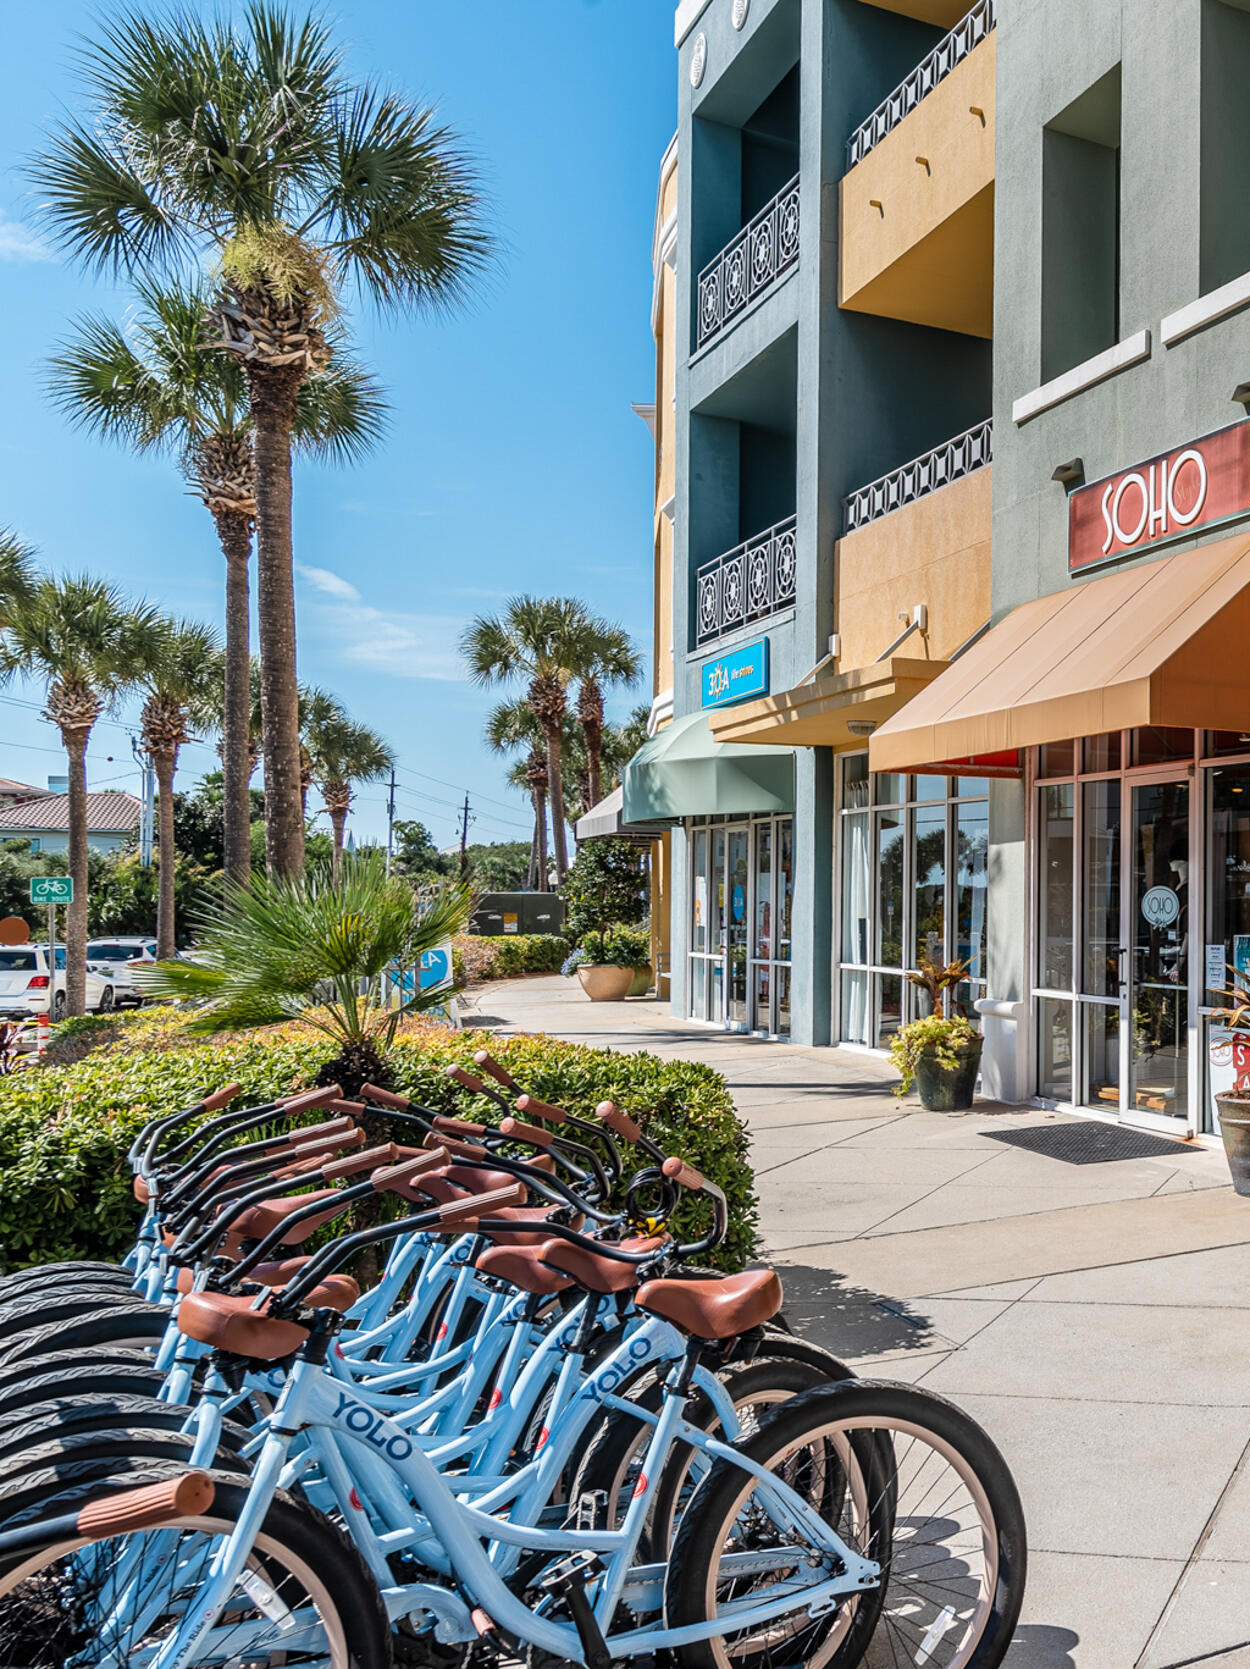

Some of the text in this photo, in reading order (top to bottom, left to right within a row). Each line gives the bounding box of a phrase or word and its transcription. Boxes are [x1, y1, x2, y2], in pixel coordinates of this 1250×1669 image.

[1101, 449, 1207, 554] SOHO
[581, 1337, 652, 1404] YOLO
[332, 1391, 413, 1461] YOLO
